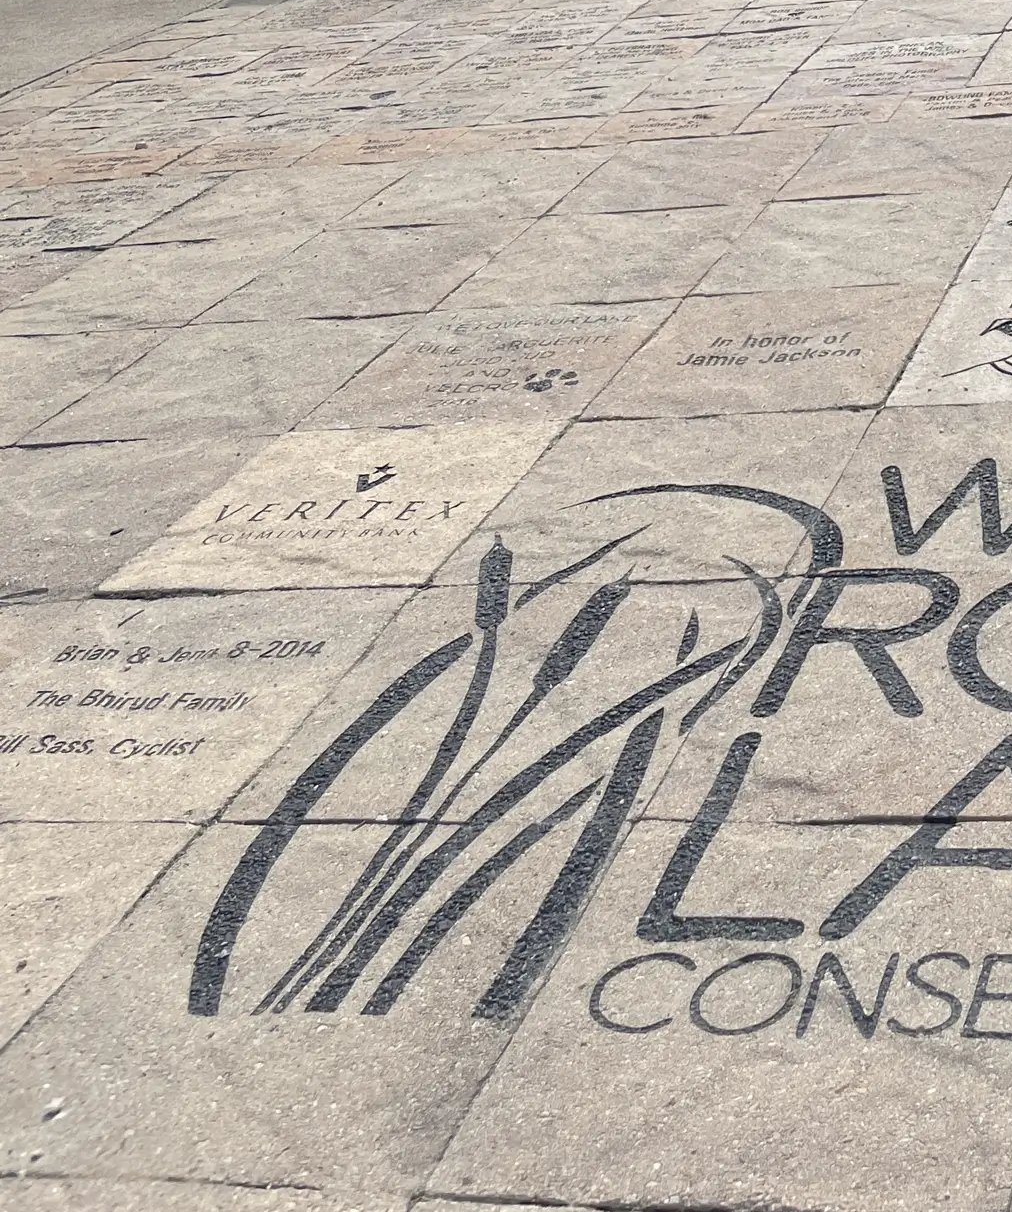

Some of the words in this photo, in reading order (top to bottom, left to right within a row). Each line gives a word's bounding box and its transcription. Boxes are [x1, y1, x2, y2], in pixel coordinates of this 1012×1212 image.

[709, 337, 734, 348] In
[741, 333, 814, 348] honor
[822, 331, 852, 345] of
[676, 352, 750, 367] Jamie
[757, 347, 862, 364] Jackson
[214, 498, 468, 524] VERITEX
[202, 528, 351, 546] COMMUNITY
[357, 527, 422, 538] BANK
[52, 644, 121, 664] Brian
[125, 646, 152, 665] &
[226, 640, 328, 660] 8-2014
[26, 690, 74, 707] The
[77, 689, 171, 711] Bhirud
[169, 692, 258, 713] Family
[29, 734, 96, 755] Sass,
[108, 737, 207, 760] Cyclist
